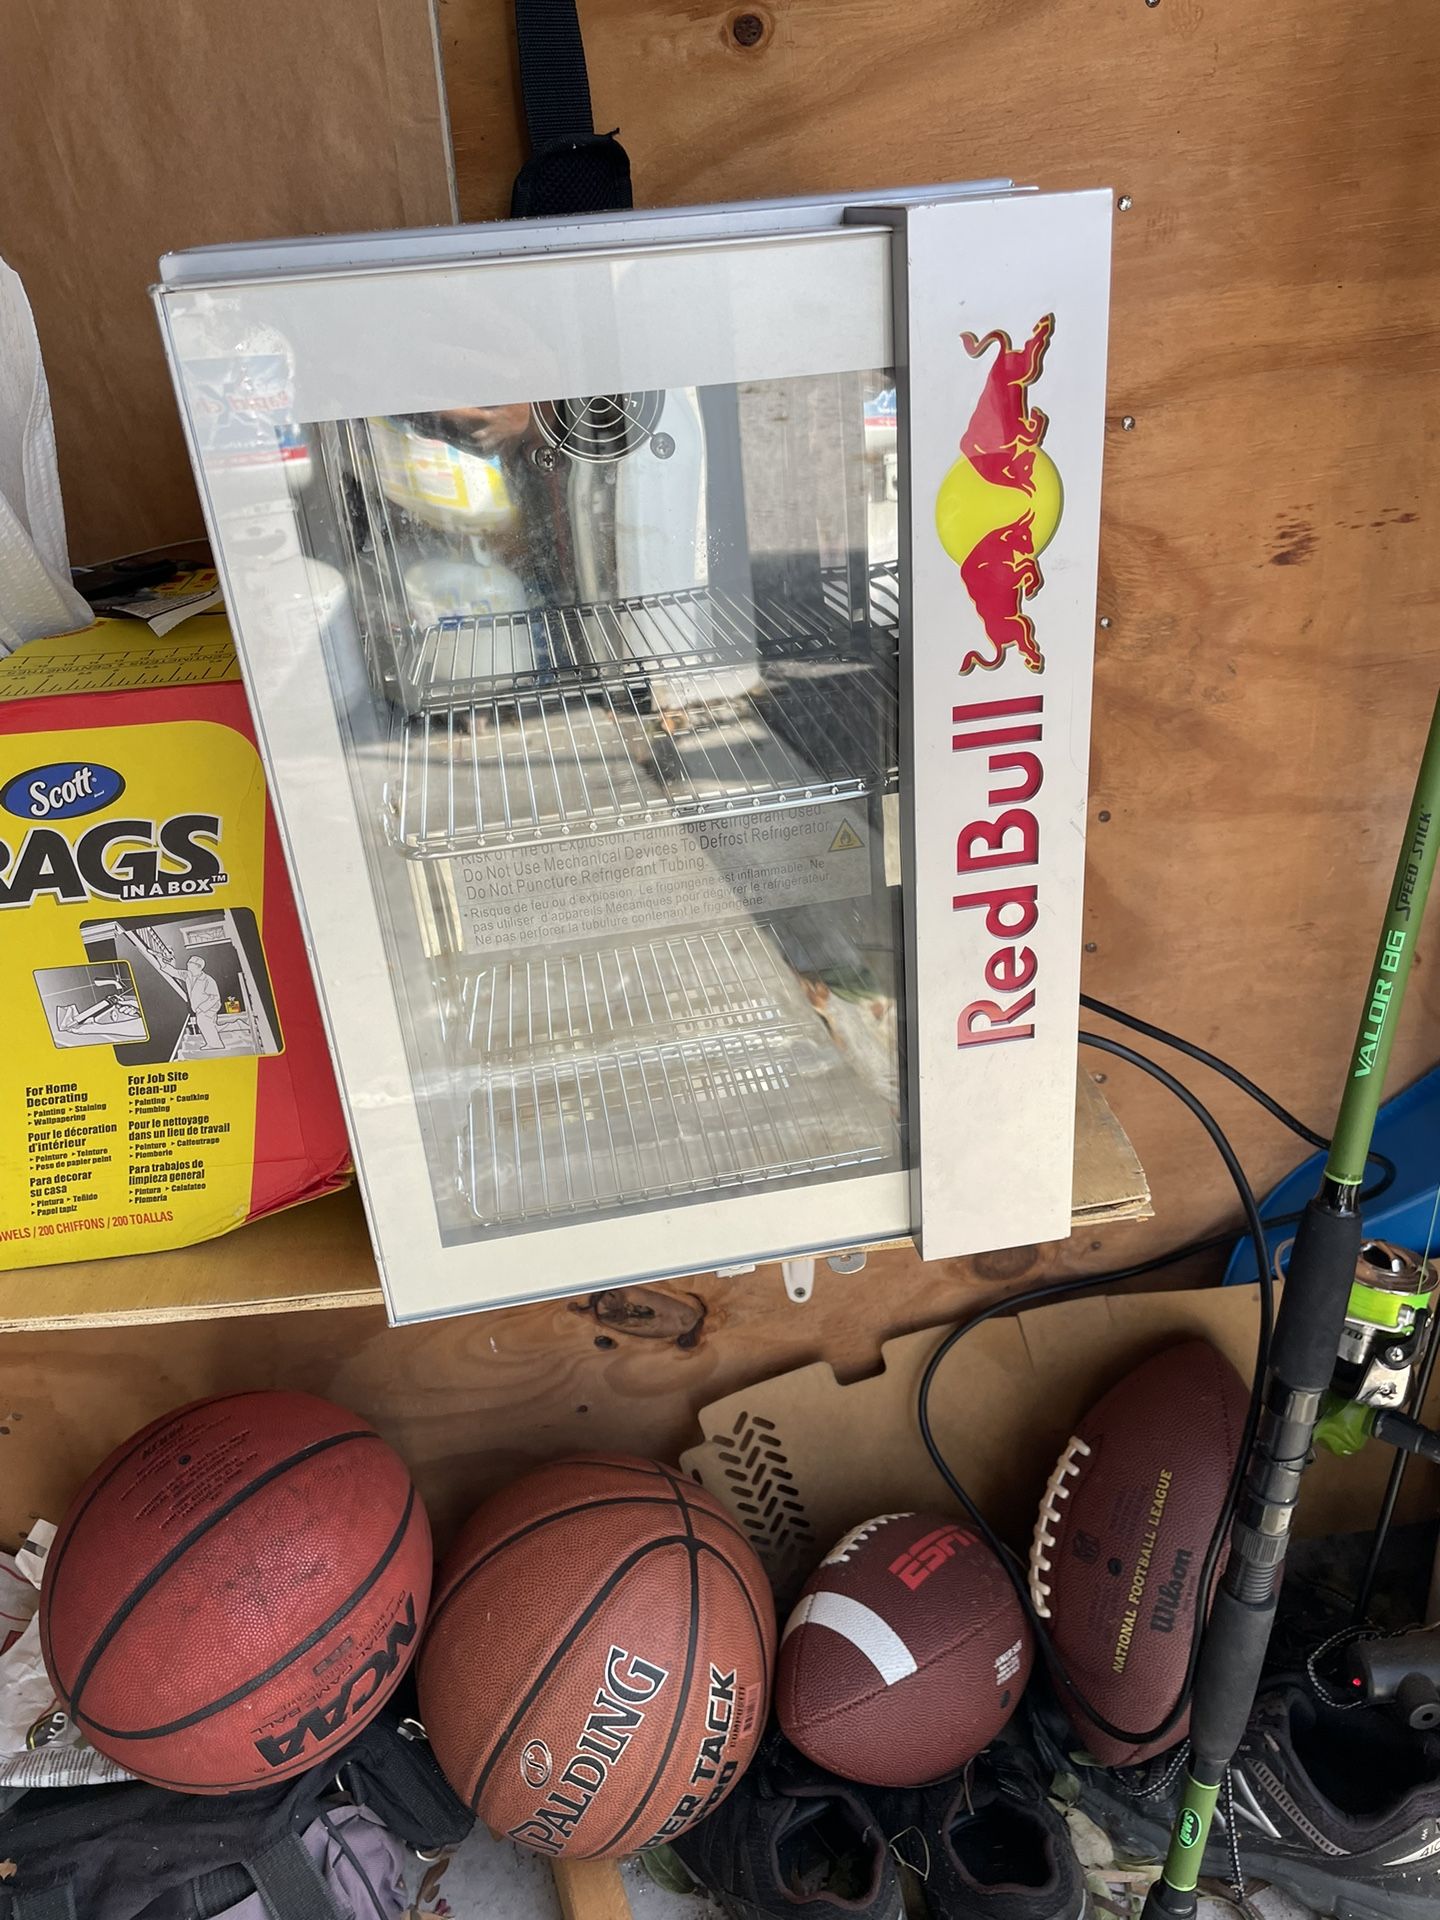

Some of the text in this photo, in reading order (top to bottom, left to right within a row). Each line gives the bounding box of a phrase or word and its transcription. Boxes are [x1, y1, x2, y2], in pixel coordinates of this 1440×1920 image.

[29, 767, 92, 817] Scott
[463, 868, 483, 883] Do
[486, 864, 511, 880] Not
[514, 861, 541, 877] Use
[544, 848, 621, 871] Mechanical
[625, 842, 678, 861] Devices
[681, 837, 698, 852] To
[699, 829, 748, 850] Defrost
[952, 694, 1044, 1049] Red Bull
[1395, 812, 1433, 921] SPEED STICK
[466, 886, 487, 900] Do
[489, 882, 514, 898] Not
[516, 874, 578, 894] Puncture
[581, 862, 658, 885] Refrigerant
[470, 904, 511, 919] Risque
[513, 902, 529, 913] de
[530, 899, 550, 911] feu
[552, 898, 566, 908] ou
[638, 885, 654, 896] Le
[720, 872, 735, 884] est
[809, 859, 825, 870] Ne
[122, 883, 146, 898] IN
[149, 882, 165, 896] A
[473, 921, 494, 935] pas
[496, 915, 534, 930] utiliser
[675, 893, 701, 908] pour
[750, 882, 761, 893] le
[475, 933, 492, 946] Ne
[495, 931, 517, 946] pas
[520, 923, 565, 941] perforer
[568, 922, 579, 933] la
[582, 915, 628, 932] tubulure
[631, 905, 690, 925] contenant
[691, 903, 700, 914] le
[1354, 929, 1406, 1078] VALOR BG
[128, 1071, 189, 1085] For Job Site
[26, 1082, 77, 1097] For Home
[128, 1084, 177, 1096] Clean-up
[26, 1092, 88, 1108] Decorating
[135, 1093, 209, 1107] Painting Caulking
[33, 1103, 106, 1117] Painting Staining
[135, 1105, 170, 1115] Plumbing
[34, 1114, 86, 1126] Wallpapering
[129, 1114, 209, 1130] Pour le nettoyage
[28, 1123, 117, 1142] Pour le décoration
[129, 1123, 230, 1141] dans un lieu de travail
[28, 1137, 87, 1153] d'intérieur
[135, 1141, 167, 1151] Peinture
[36, 1148, 108, 1162] Peinture Teinture
[135, 1149, 173, 1159] Plomberie
[36, 1155, 112, 1171] Pose de papier peint
[129, 1159, 204, 1174] Para trabajos de
[30, 1170, 92, 1187] Para decorar
[129, 1169, 205, 1186] limpieza general
[30, 1184, 67, 1198] su casa
[135, 1186, 161, 1195] Pintura
[37, 1197, 64, 1207] Pintura
[37, 1204, 77, 1216] Papel tapiz
[38, 1223, 55, 1237] 200
[56, 1218, 105, 1234] CHIFFONS
[112, 1215, 128, 1228] 200
[129, 1210, 174, 1226] TOALLAS
[1112, 1468, 1173, 1674] NATIONAL FOOTBALL LEAGUE
[1150, 1548, 1193, 1633] Wilson
[359, 1589, 406, 1659] OFFICIAL
[254, 1591, 417, 1767] NCAA
[306, 1664, 354, 1707] GAME
[250, 1706, 302, 1734] BALL
[688, 1662, 737, 1786] TACK
